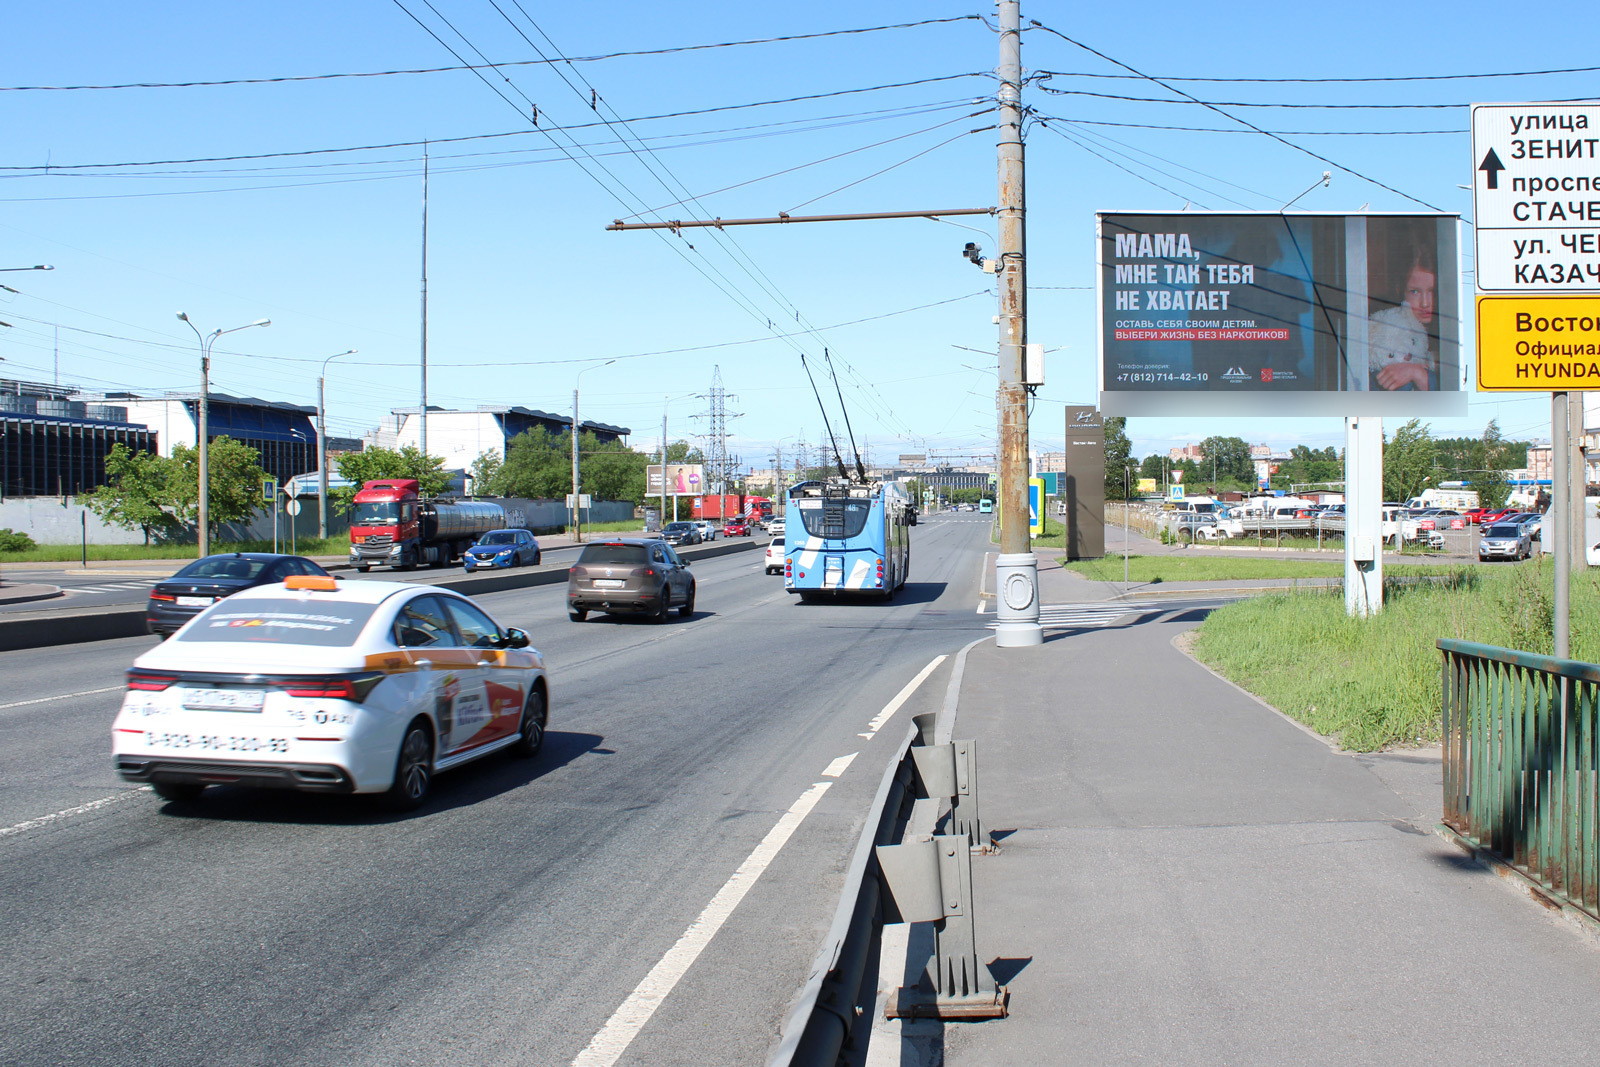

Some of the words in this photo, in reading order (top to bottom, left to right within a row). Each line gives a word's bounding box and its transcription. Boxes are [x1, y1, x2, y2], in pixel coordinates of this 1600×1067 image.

[1510, 114, 1588, 135] улица
[1511, 138, 1600, 159] ЗЕНИТ
[1512, 176, 1600, 197] проспе
[1513, 201, 1600, 222] СТАЧЕ
[1115, 233, 1200, 261] МАМА,
[1513, 239, 1551, 260] ул.
[1560, 233, 1600, 254] ЧЕ
[1115, 264, 1158, 284] МНЕ
[1163, 264, 1200, 284] ТАК
[1206, 264, 1254, 285] ТЕБЯ
[1514, 263, 1600, 284] КАЗАЧ
[1115, 290, 1140, 311] НЕ
[1145, 290, 1231, 311] ХВАТАЕТ
[1115, 319, 1154, 329] ОСТАВЬ
[1156, 319, 1183, 329] СЕБЯ
[1184, 319, 1220, 329] СВОИМ
[1221, 319, 1258, 330] ДЕТЯМ.
[1115, 331, 1158, 340] ВЫБЕРИ
[1160, 331, 1196, 340] ЖИЗНЬ
[1197, 331, 1217, 340] БЕЗ
[1219, 331, 1288, 340] НАРКОТИКОВ!
[1515, 340, 1600, 360] Официа
[1116, 373, 1129, 382] +7
[1130, 372, 1155, 383] (812)
[1117, 363, 1144, 371] Телефон
[1516, 362, 1600, 379] HYUNDA
